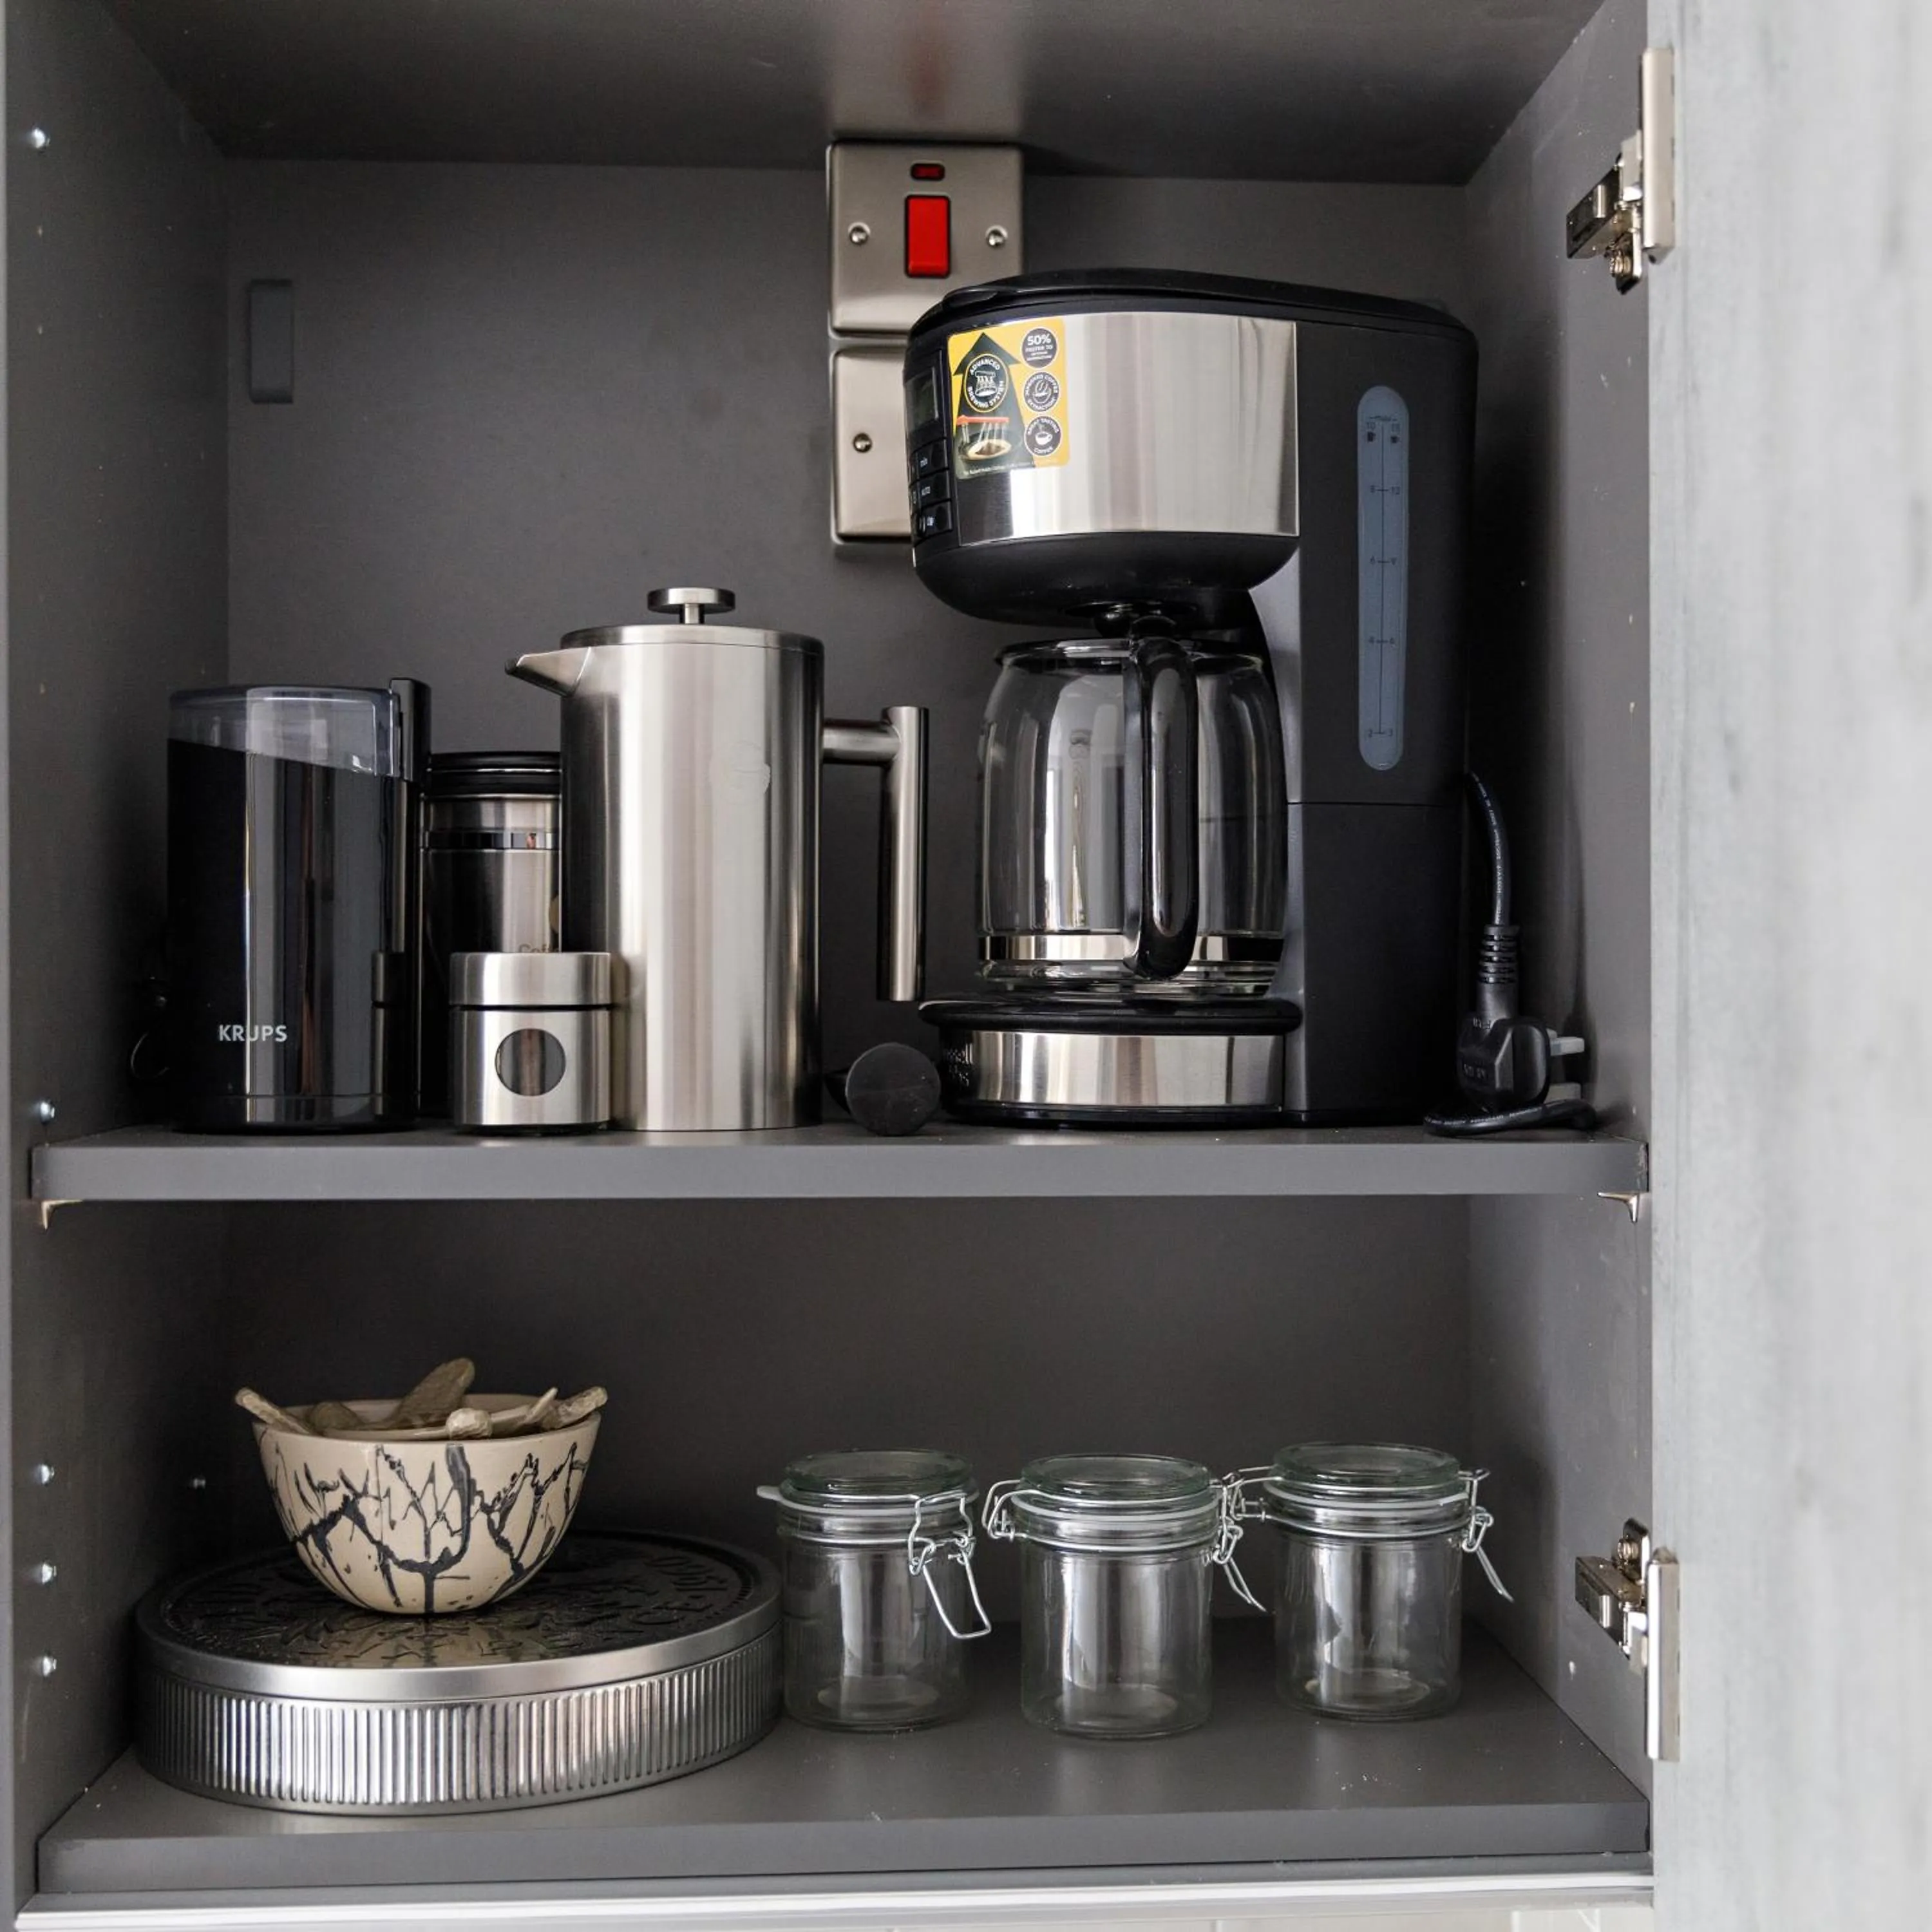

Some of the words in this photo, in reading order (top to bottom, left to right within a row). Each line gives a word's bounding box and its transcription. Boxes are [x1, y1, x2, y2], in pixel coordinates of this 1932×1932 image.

[1027, 334, 1052, 346] 50%
[970, 358, 1000, 375] ADVANCED
[218, 1024, 288, 1043] KRUPS
